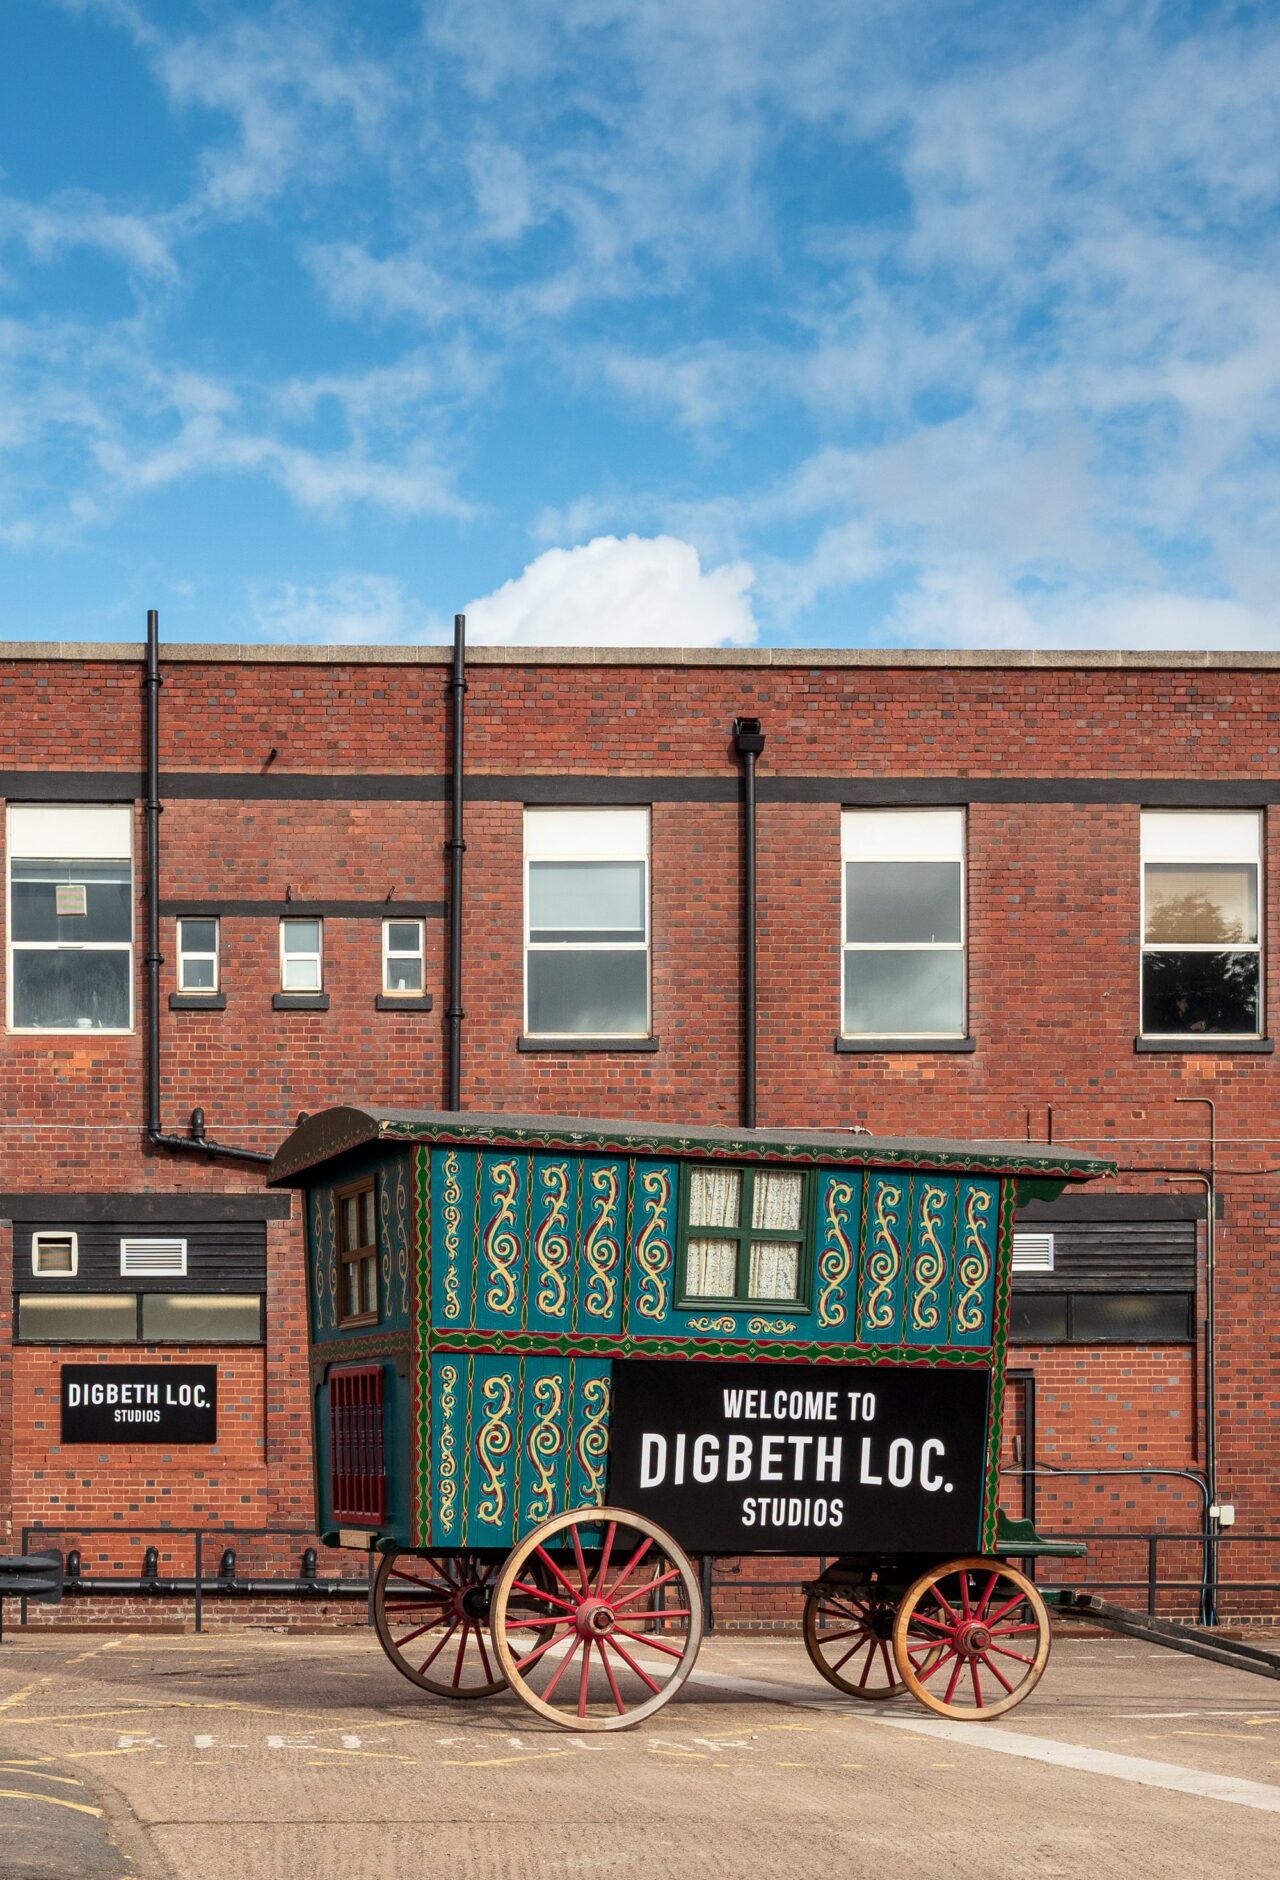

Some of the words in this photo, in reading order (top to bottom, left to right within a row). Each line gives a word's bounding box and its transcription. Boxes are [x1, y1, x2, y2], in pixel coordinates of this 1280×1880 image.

[68, 1383, 159, 1407] DIGBETH
[166, 1384, 211, 1409] LOC.
[723, 1389, 838, 1420] WELCOME
[848, 1392, 876, 1421] TO
[114, 1409, 161, 1423] STUDIOS
[639, 1432, 843, 1488] DIGBETH
[859, 1437, 954, 1493] LOC.
[741, 1497, 844, 1527] STUDIOS
